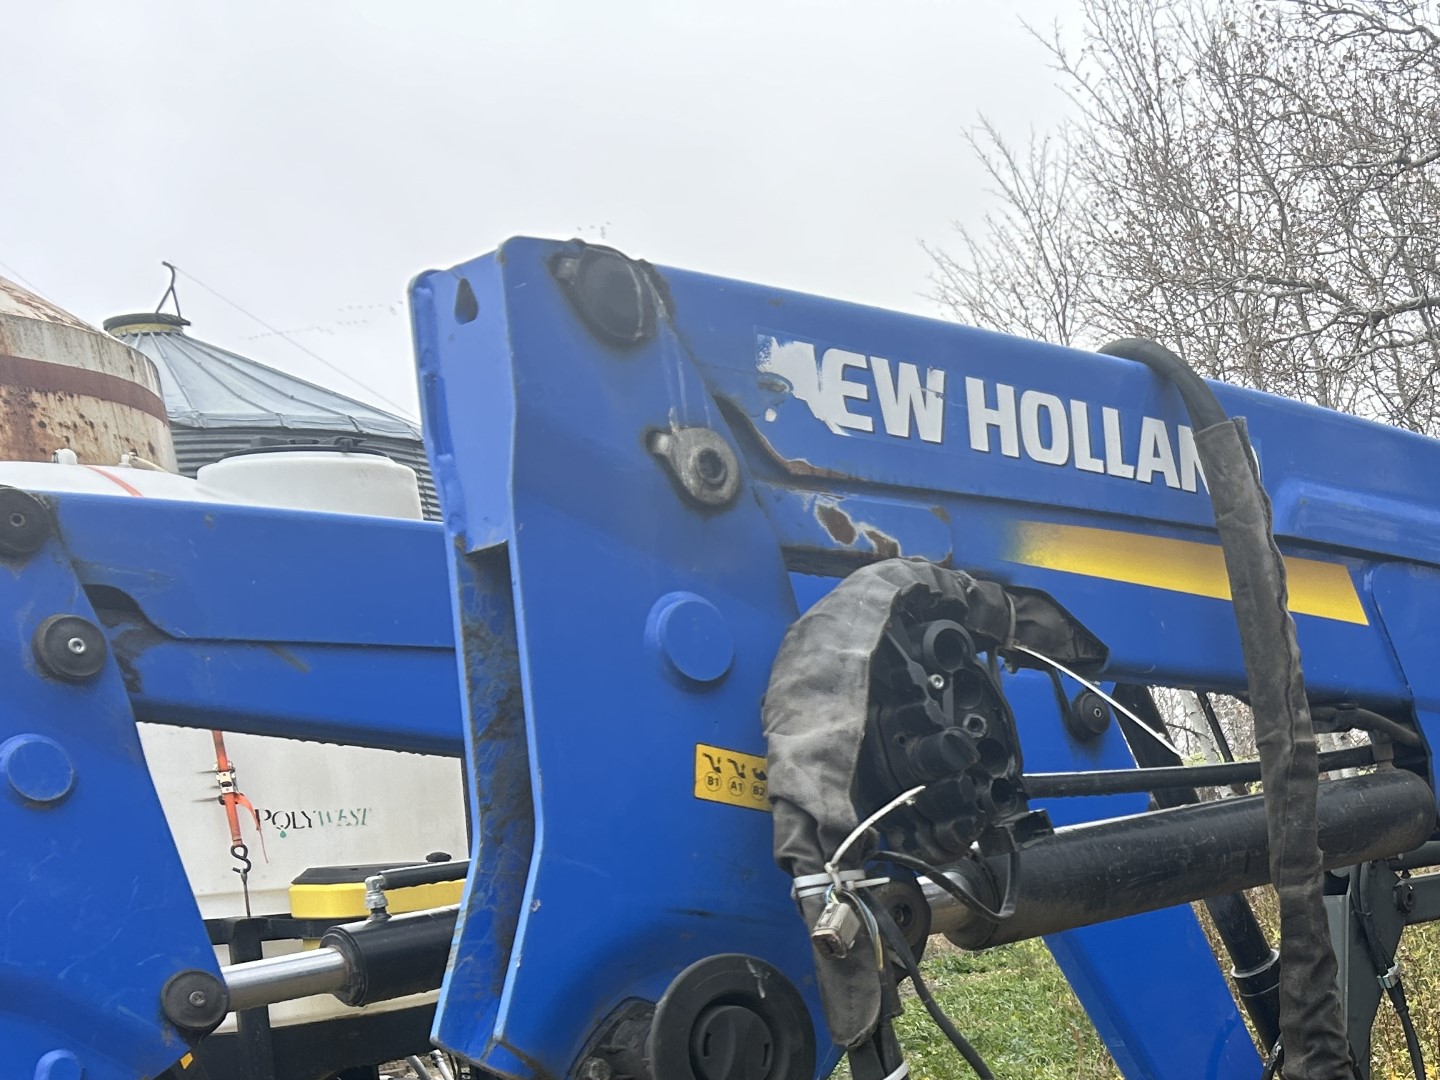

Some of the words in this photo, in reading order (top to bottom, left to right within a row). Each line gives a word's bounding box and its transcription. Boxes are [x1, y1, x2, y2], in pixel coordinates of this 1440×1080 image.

[964, 377, 1261, 496] HOLLAN
[707, 775, 720, 787] B1
[730, 781, 743, 792] A1
[752, 785, 766, 797] B2
